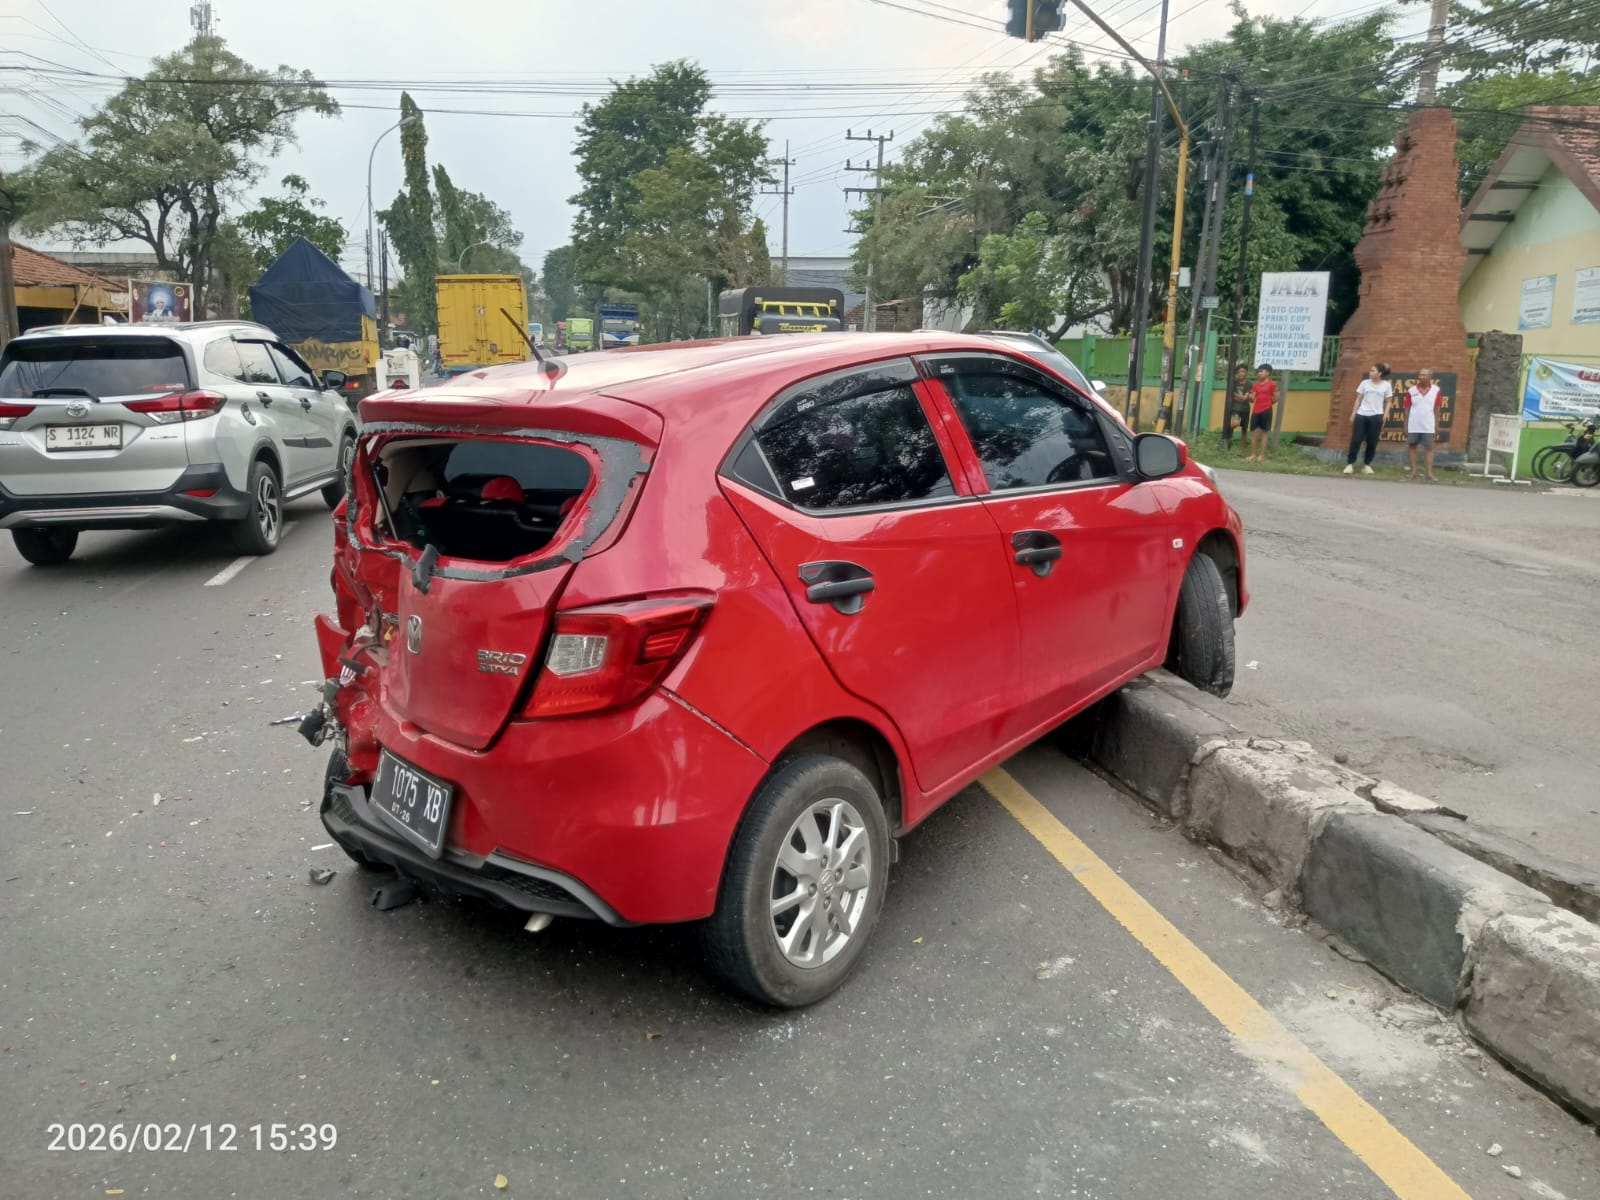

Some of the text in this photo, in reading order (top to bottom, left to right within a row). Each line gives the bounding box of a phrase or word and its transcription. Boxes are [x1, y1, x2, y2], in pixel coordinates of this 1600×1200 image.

[1266, 306, 1310, 314] FOTO COPY
[1265, 315, 1312, 323] PRINT COPY
[1264, 324, 1305, 332] PRINT OUT
[1263, 332, 1311, 341] LAMINATING
[1262, 341, 1320, 350] PRINT BANNER
[1261, 350, 1308, 358] CETAK FOTO
[49, 426, 119, 441] S 1124 NR
[478, 649, 527, 665] BRIO
[391, 764, 420, 808] 1075
[423, 784, 442, 823] XB
